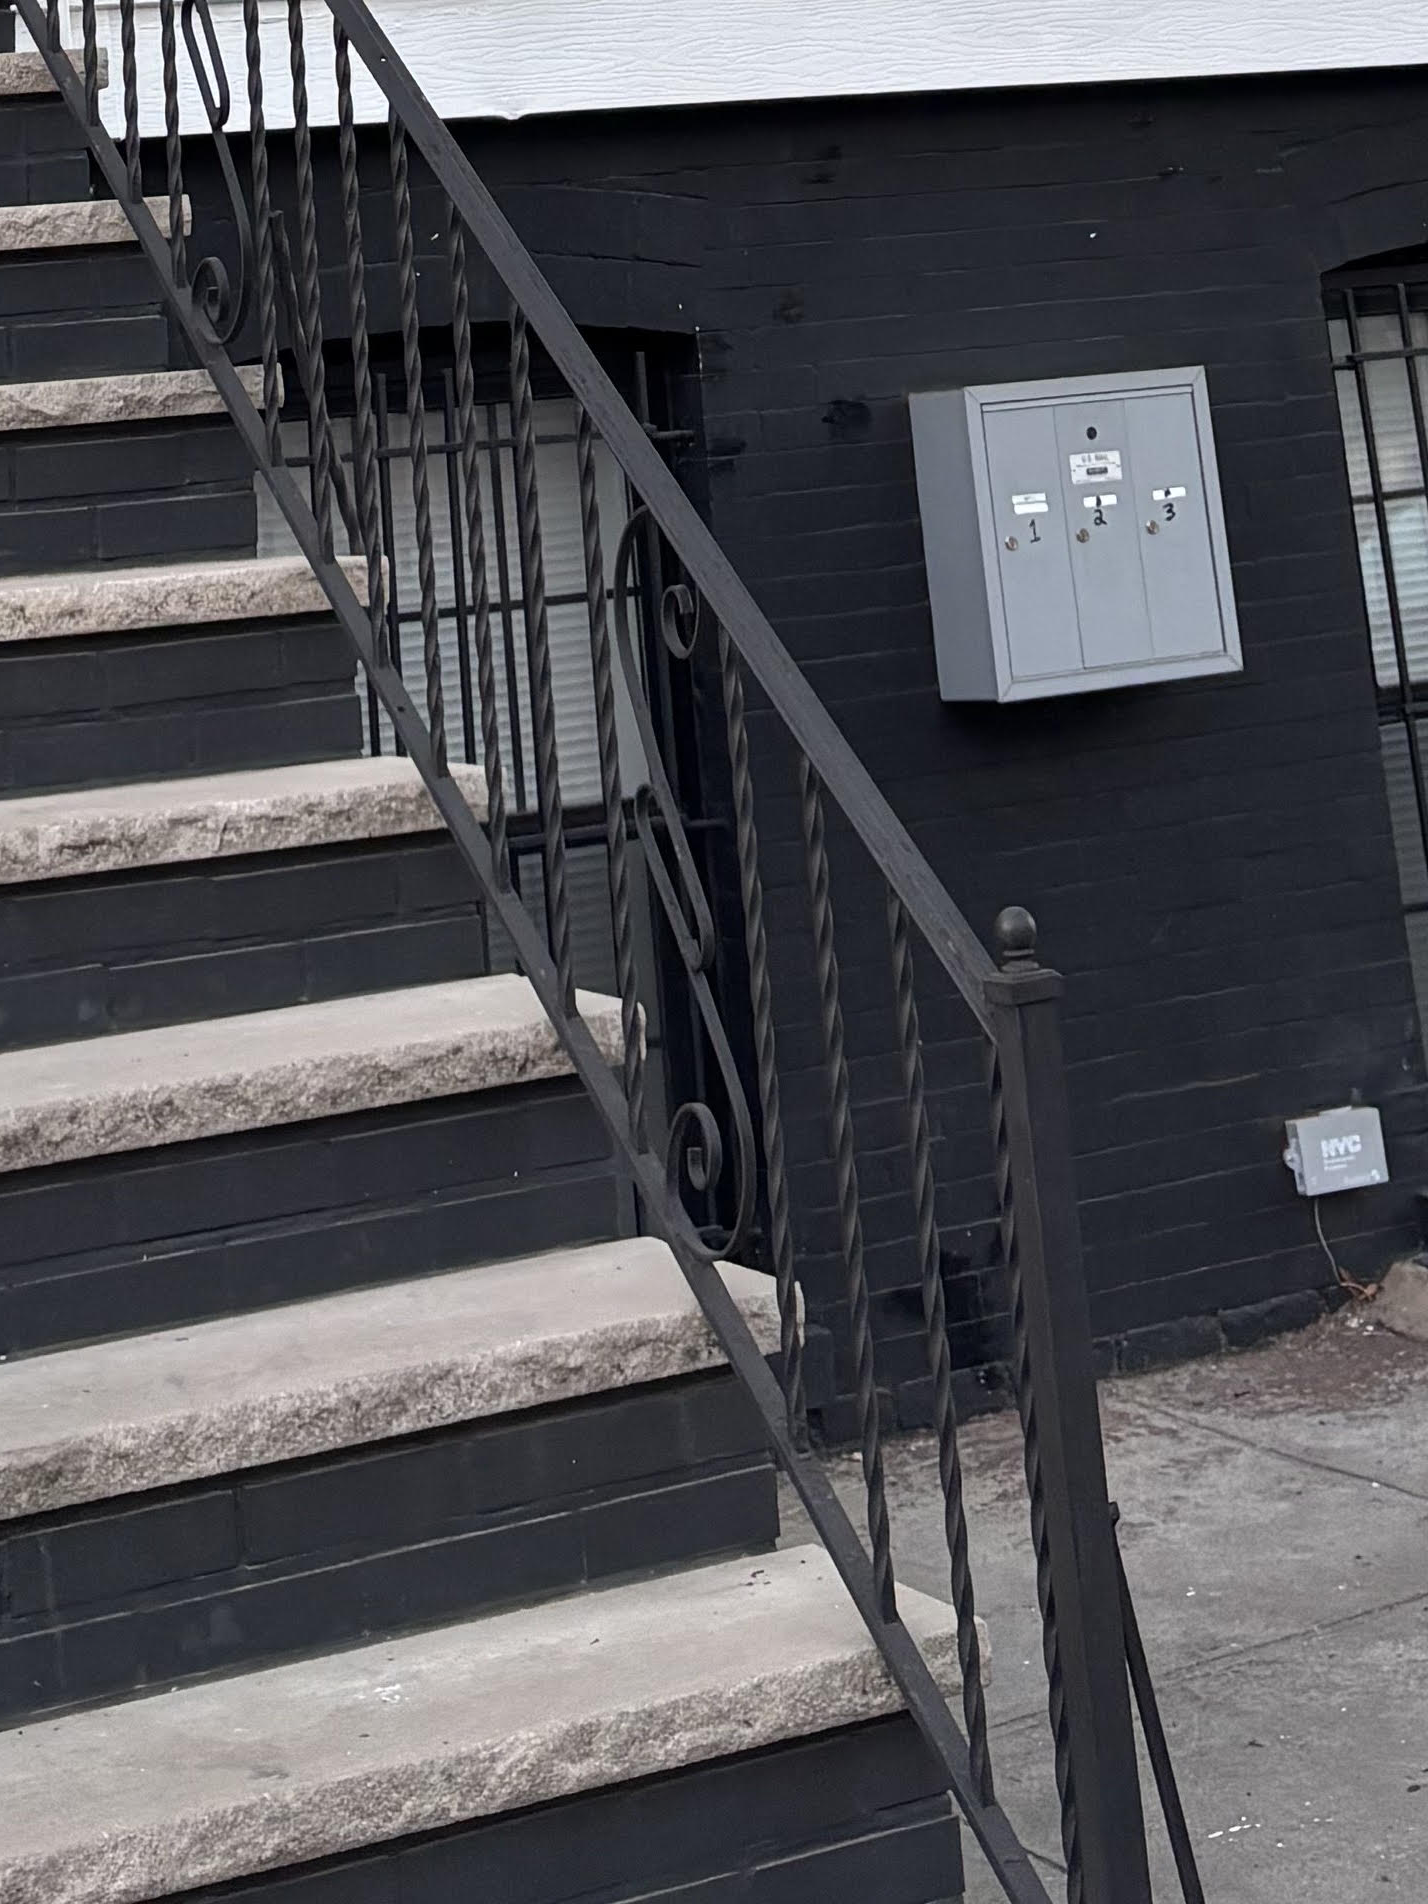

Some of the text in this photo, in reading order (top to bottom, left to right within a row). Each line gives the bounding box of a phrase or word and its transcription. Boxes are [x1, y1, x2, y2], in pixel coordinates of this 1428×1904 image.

[1093, 509, 1108, 527] 2
[1162, 502, 1177, 522] 3
[1029, 518, 1042, 544] 1
[1321, 1134, 1362, 1159] NYC
